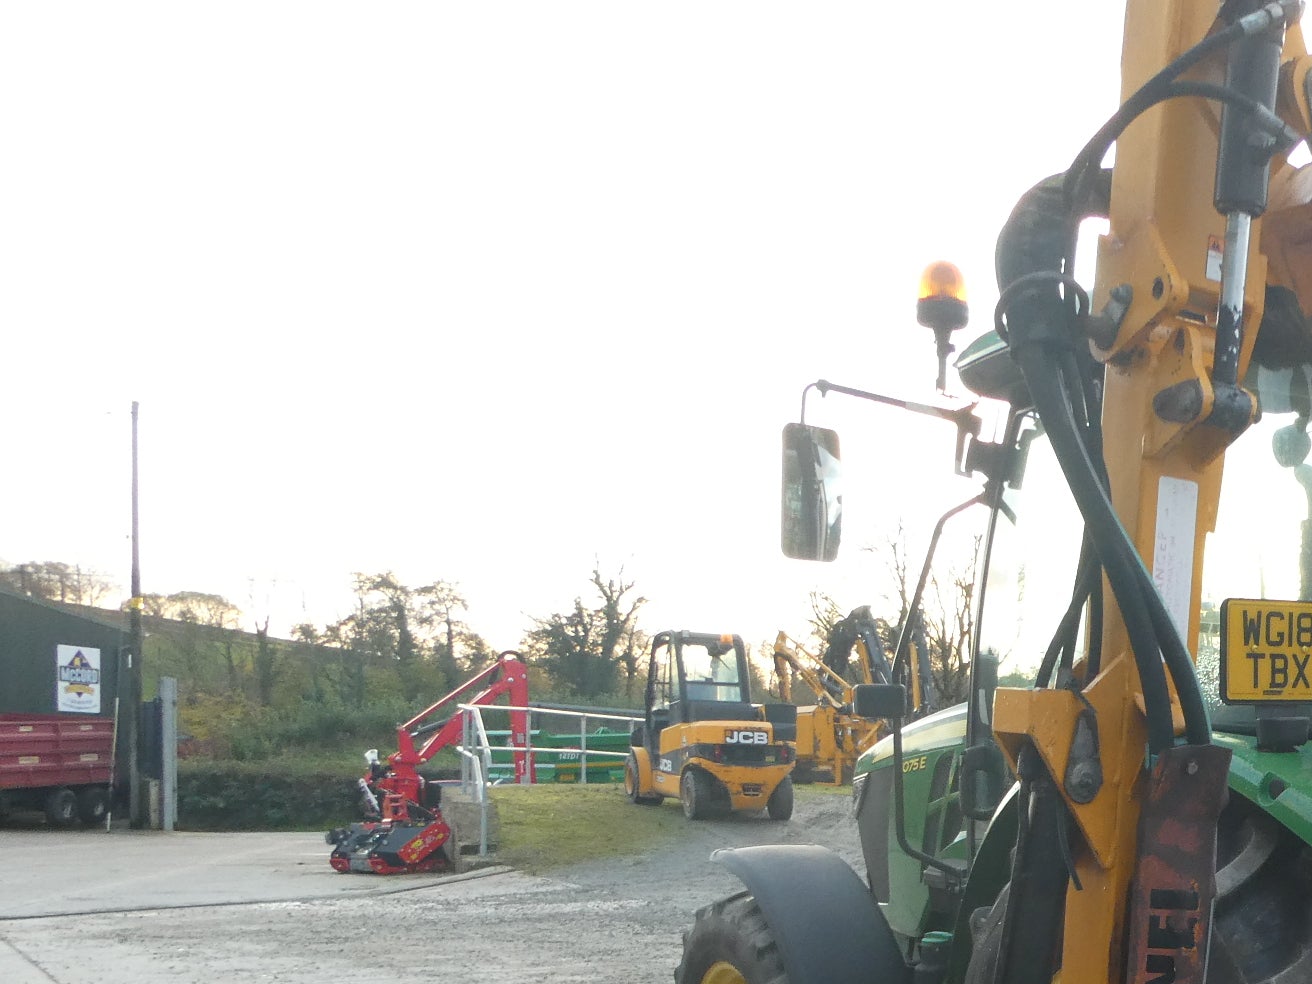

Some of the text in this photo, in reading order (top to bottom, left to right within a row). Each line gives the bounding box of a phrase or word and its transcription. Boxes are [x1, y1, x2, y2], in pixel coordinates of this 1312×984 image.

[1246, 653, 1310, 688] TBX
[726, 731, 768, 744] JCB
[660, 759, 672, 772] JCB
